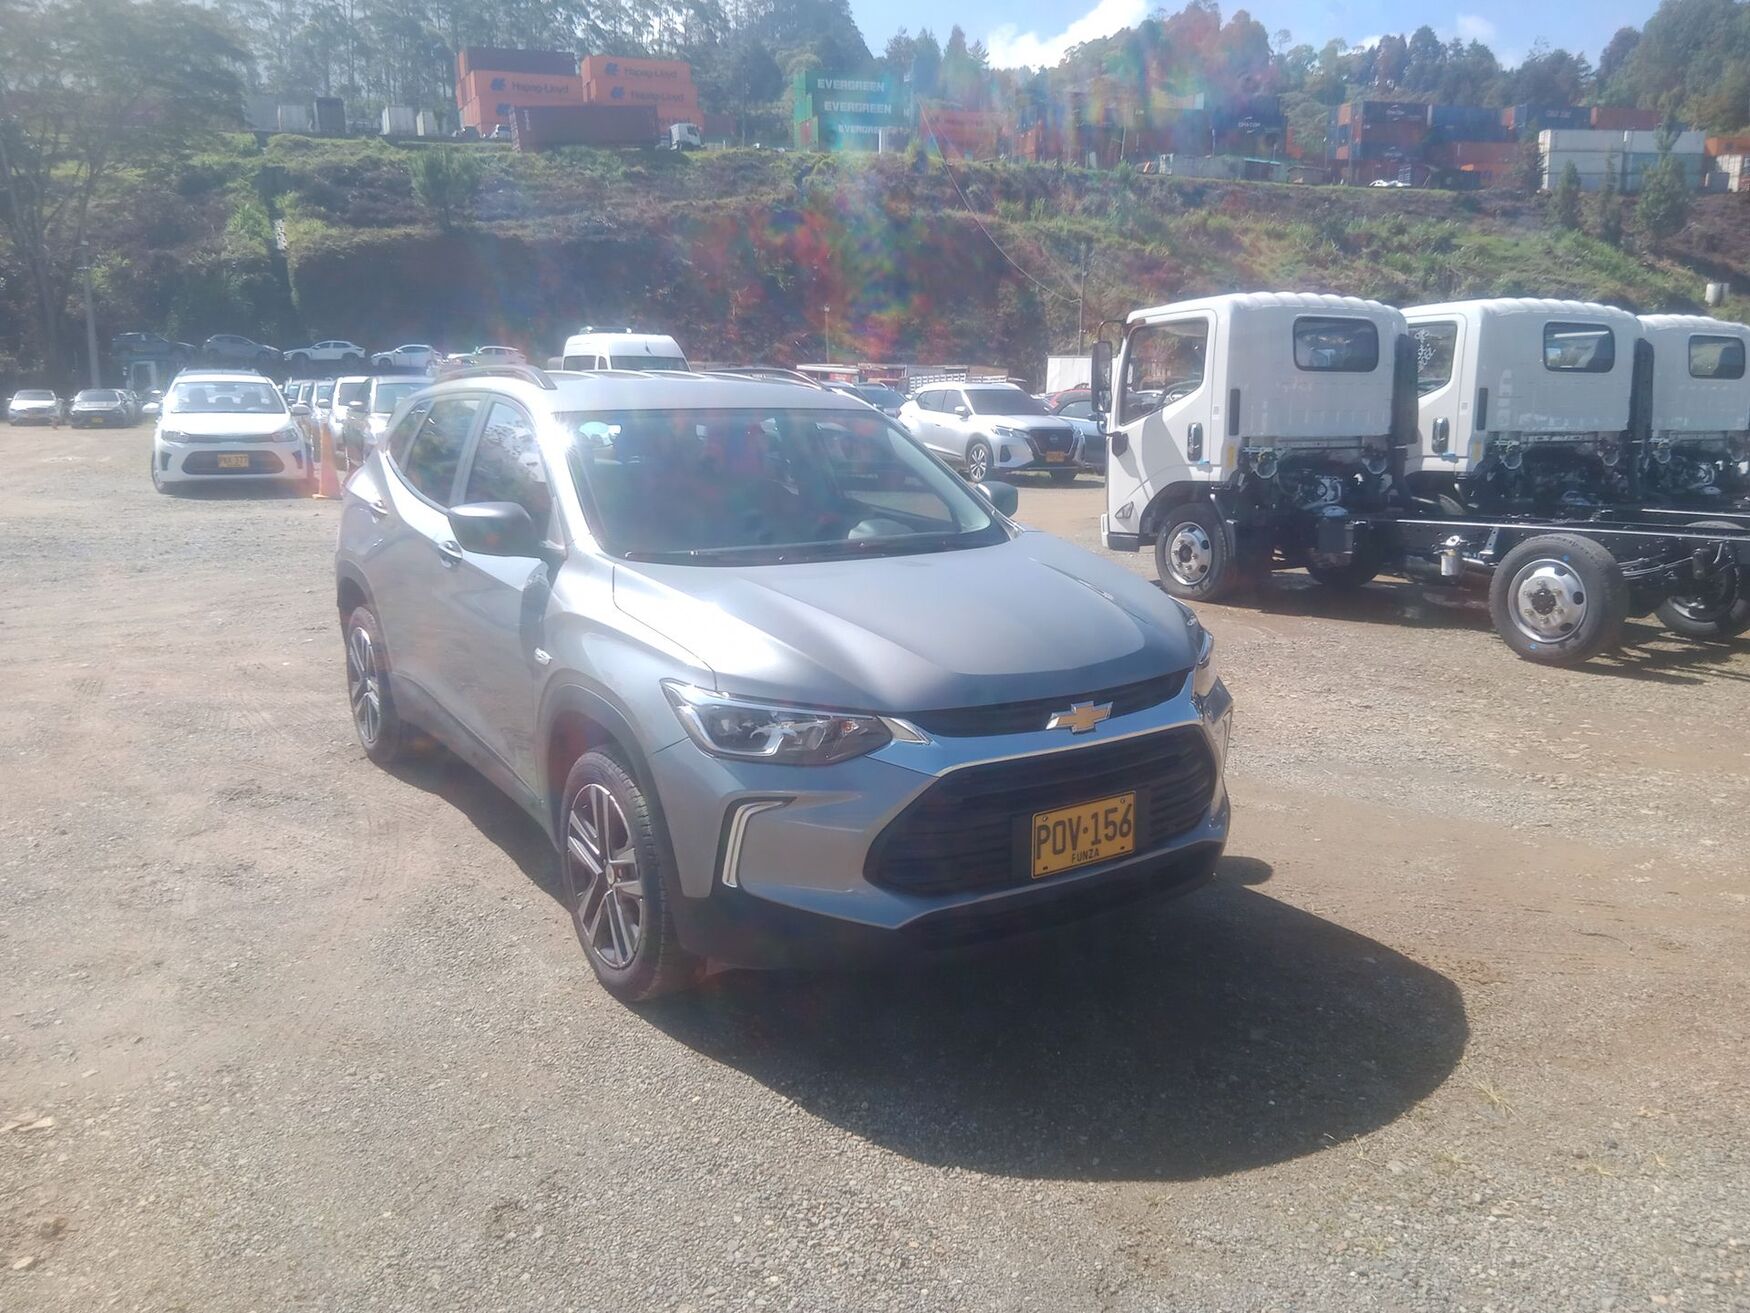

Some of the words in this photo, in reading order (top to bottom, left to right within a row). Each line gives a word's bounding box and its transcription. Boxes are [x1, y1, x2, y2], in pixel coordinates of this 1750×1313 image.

[817, 78, 885, 92] EVERGREEN
[823, 101, 892, 114] EVERGREEN
[1071, 848, 1100, 863] FUNZA
